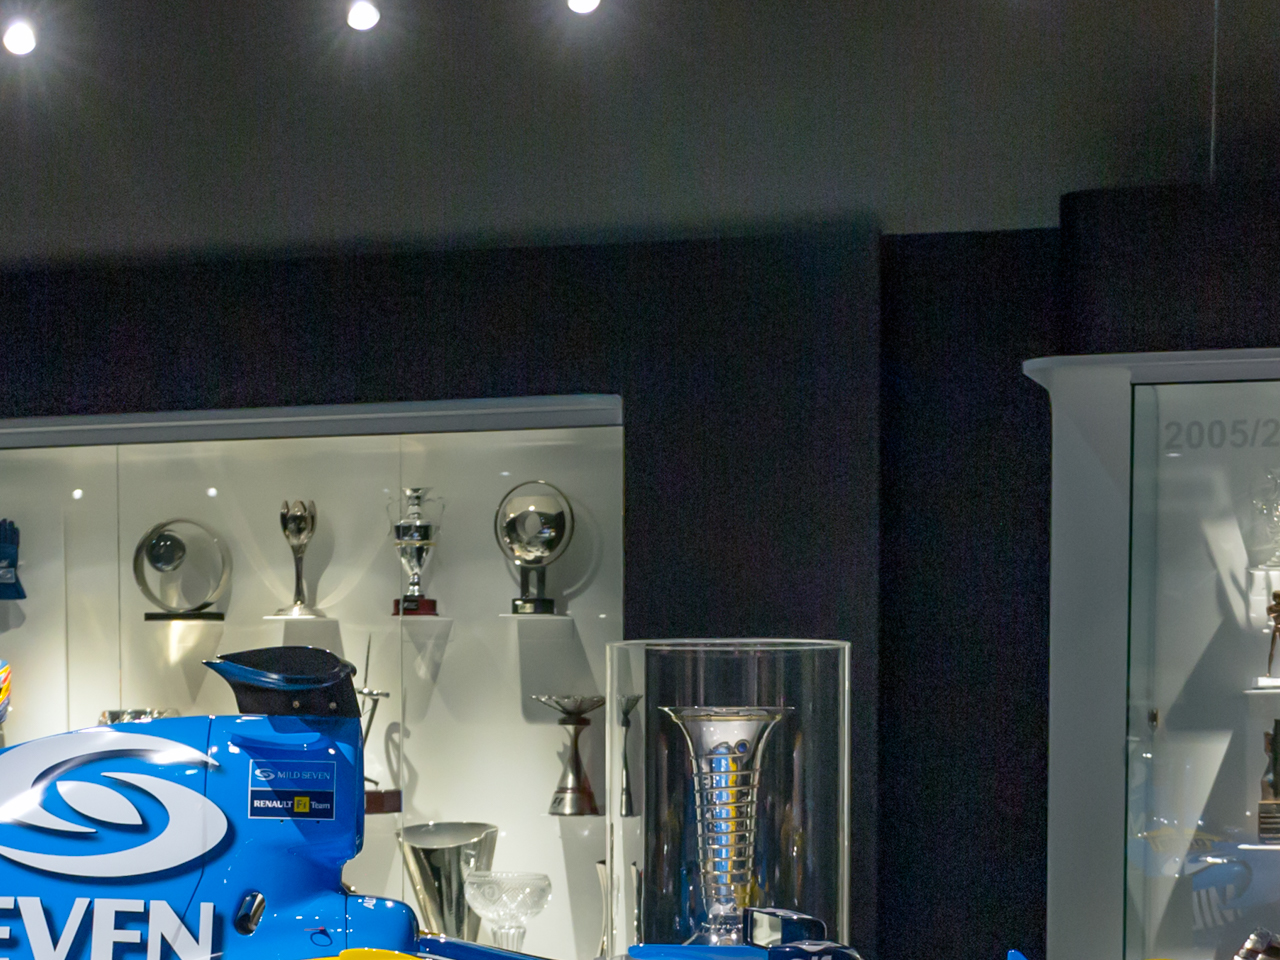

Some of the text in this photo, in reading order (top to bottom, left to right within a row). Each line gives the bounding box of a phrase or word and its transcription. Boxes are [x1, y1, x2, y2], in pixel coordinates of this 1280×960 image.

[278, 771, 330, 780] MILD SEVEN
[254, 800, 292, 808] RENAULT
